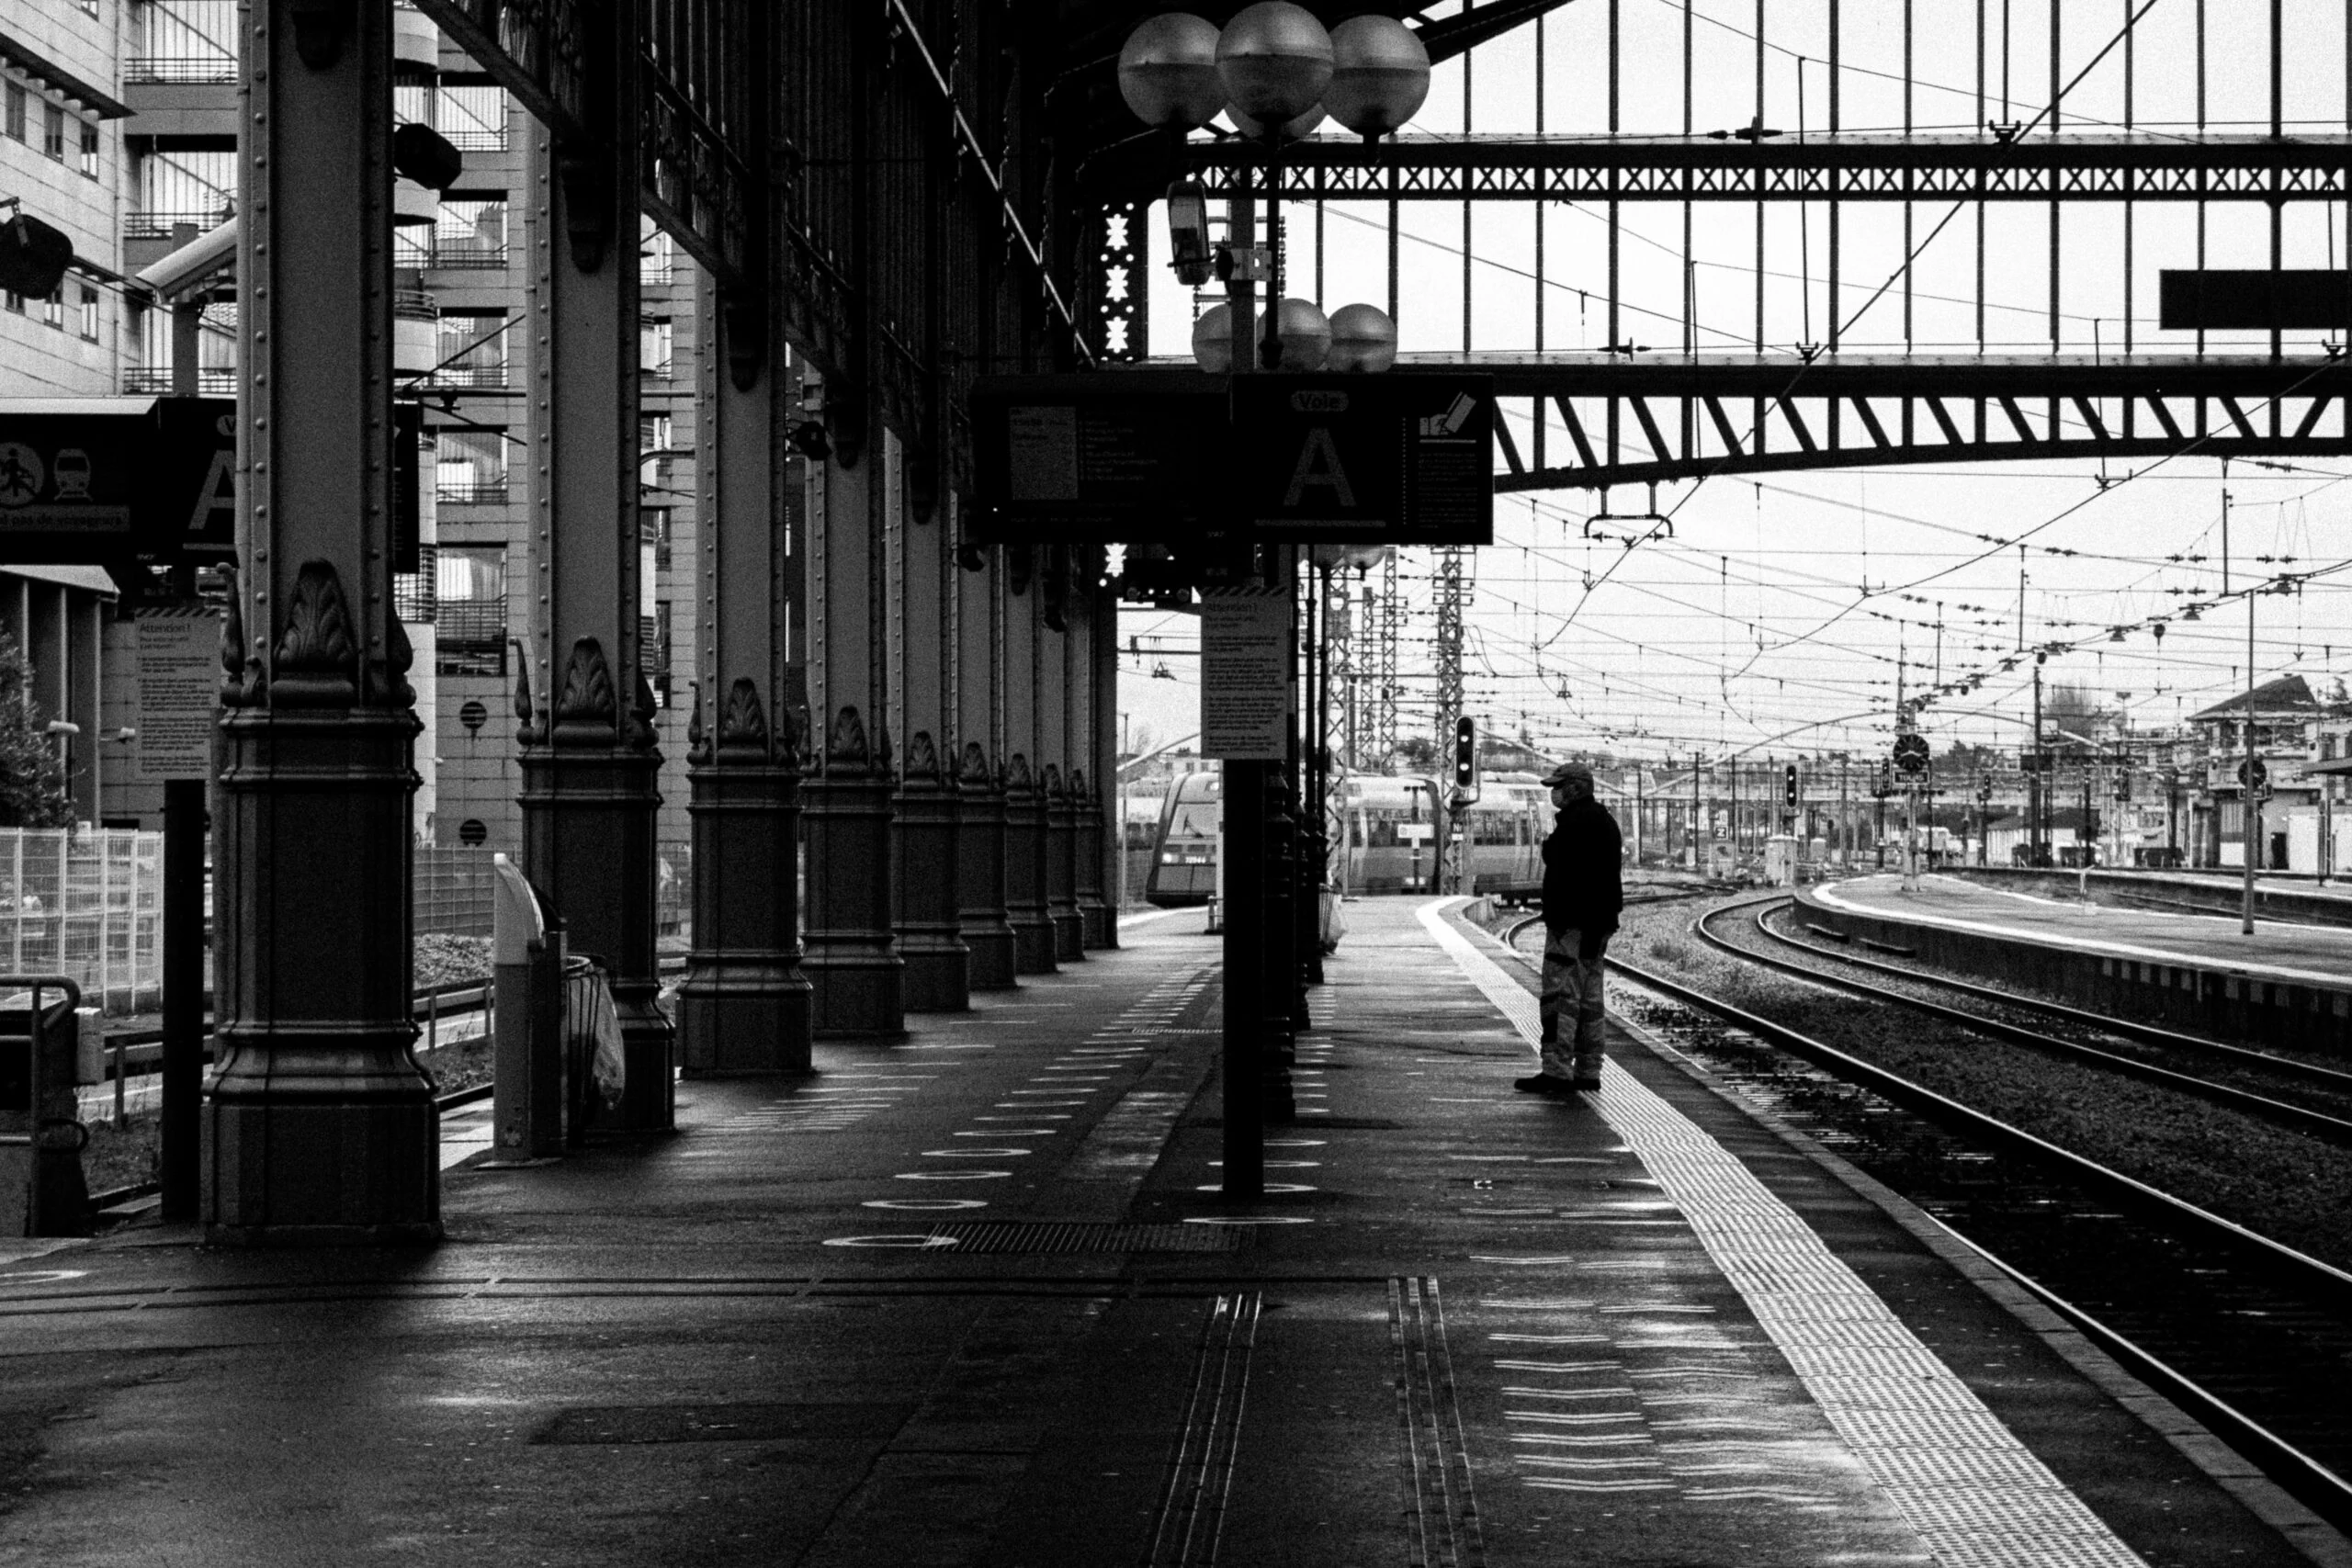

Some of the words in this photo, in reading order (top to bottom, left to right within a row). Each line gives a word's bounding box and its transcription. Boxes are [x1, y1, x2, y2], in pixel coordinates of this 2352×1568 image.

[1298, 393, 1340, 410] Voie
[1283, 427, 1357, 506] A
[140, 624, 185, 633] Attention
